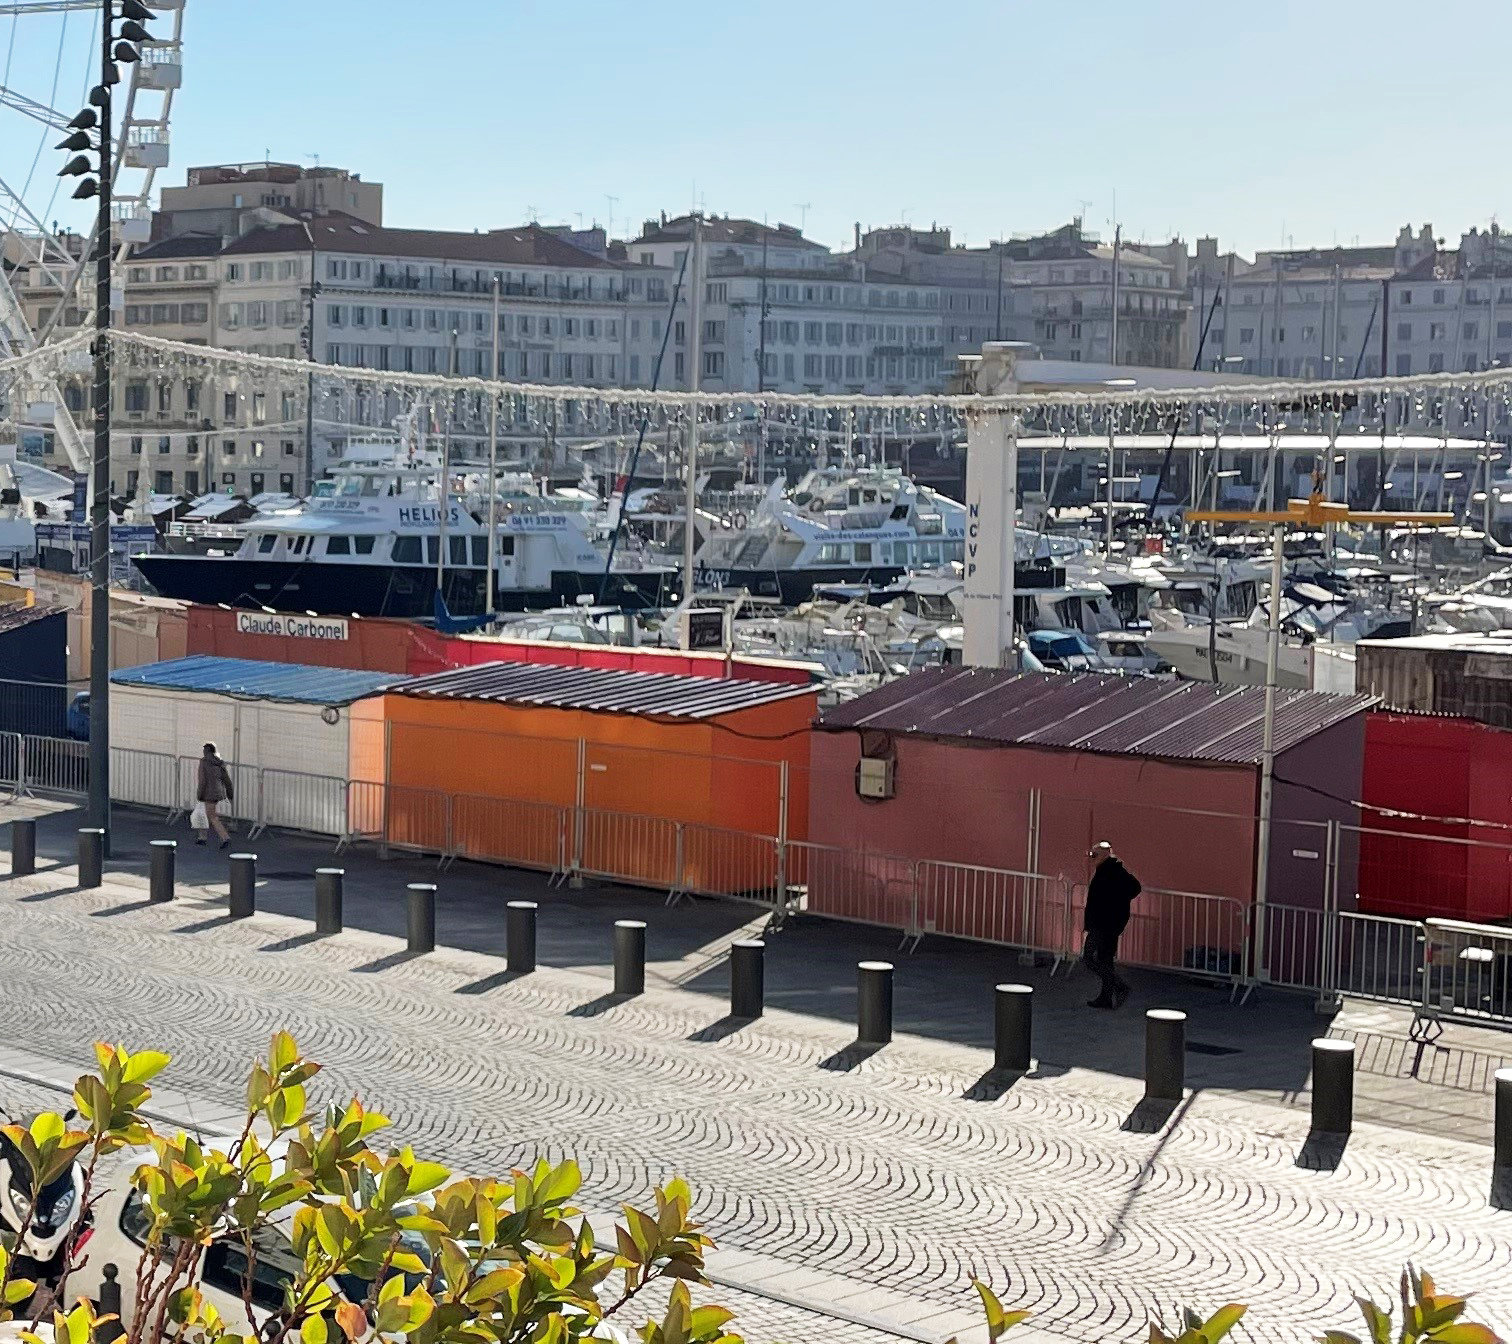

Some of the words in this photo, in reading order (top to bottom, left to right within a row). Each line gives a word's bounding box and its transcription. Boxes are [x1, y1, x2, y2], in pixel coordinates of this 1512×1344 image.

[399, 508, 459, 521] HELIOS
[240, 614, 282, 635] Claude
[287, 618, 345, 640] Carbonel
